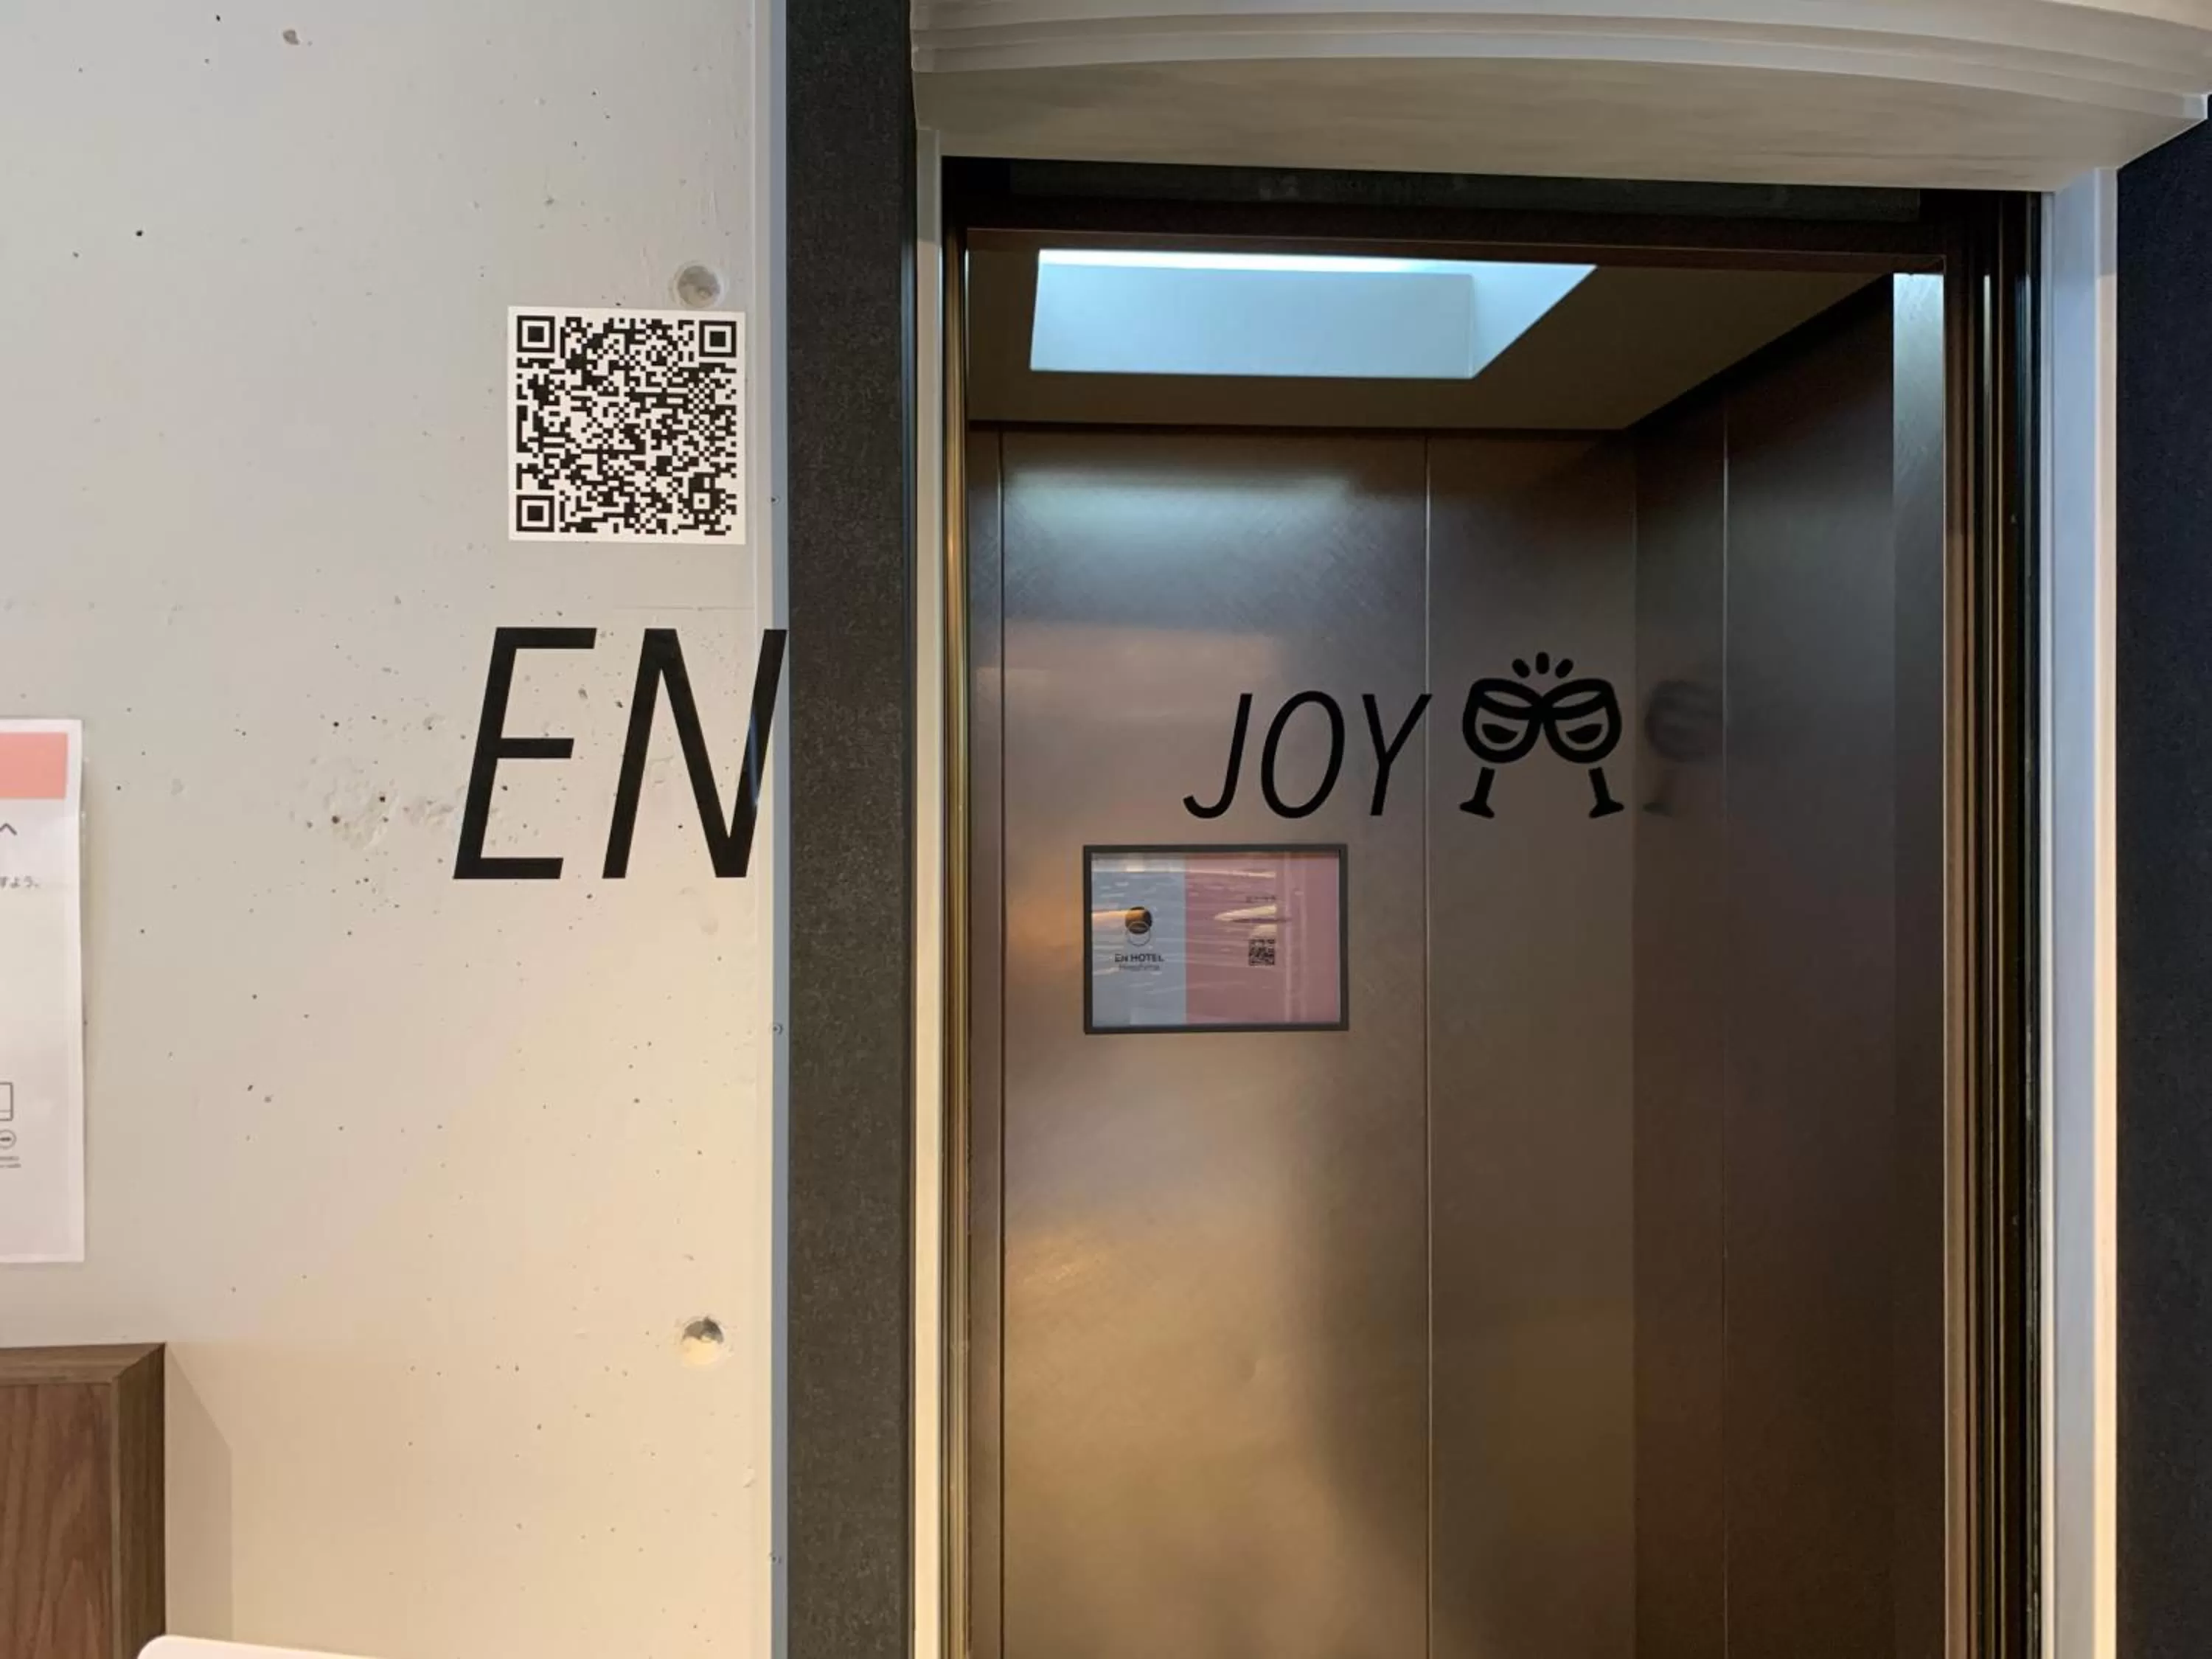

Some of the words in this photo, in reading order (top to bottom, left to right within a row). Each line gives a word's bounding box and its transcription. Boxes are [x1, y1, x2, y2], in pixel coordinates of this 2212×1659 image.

[453, 627, 787, 879] EN
[1183, 690, 1432, 819] JOY
[1130, 953, 1165, 962] HOTEL
